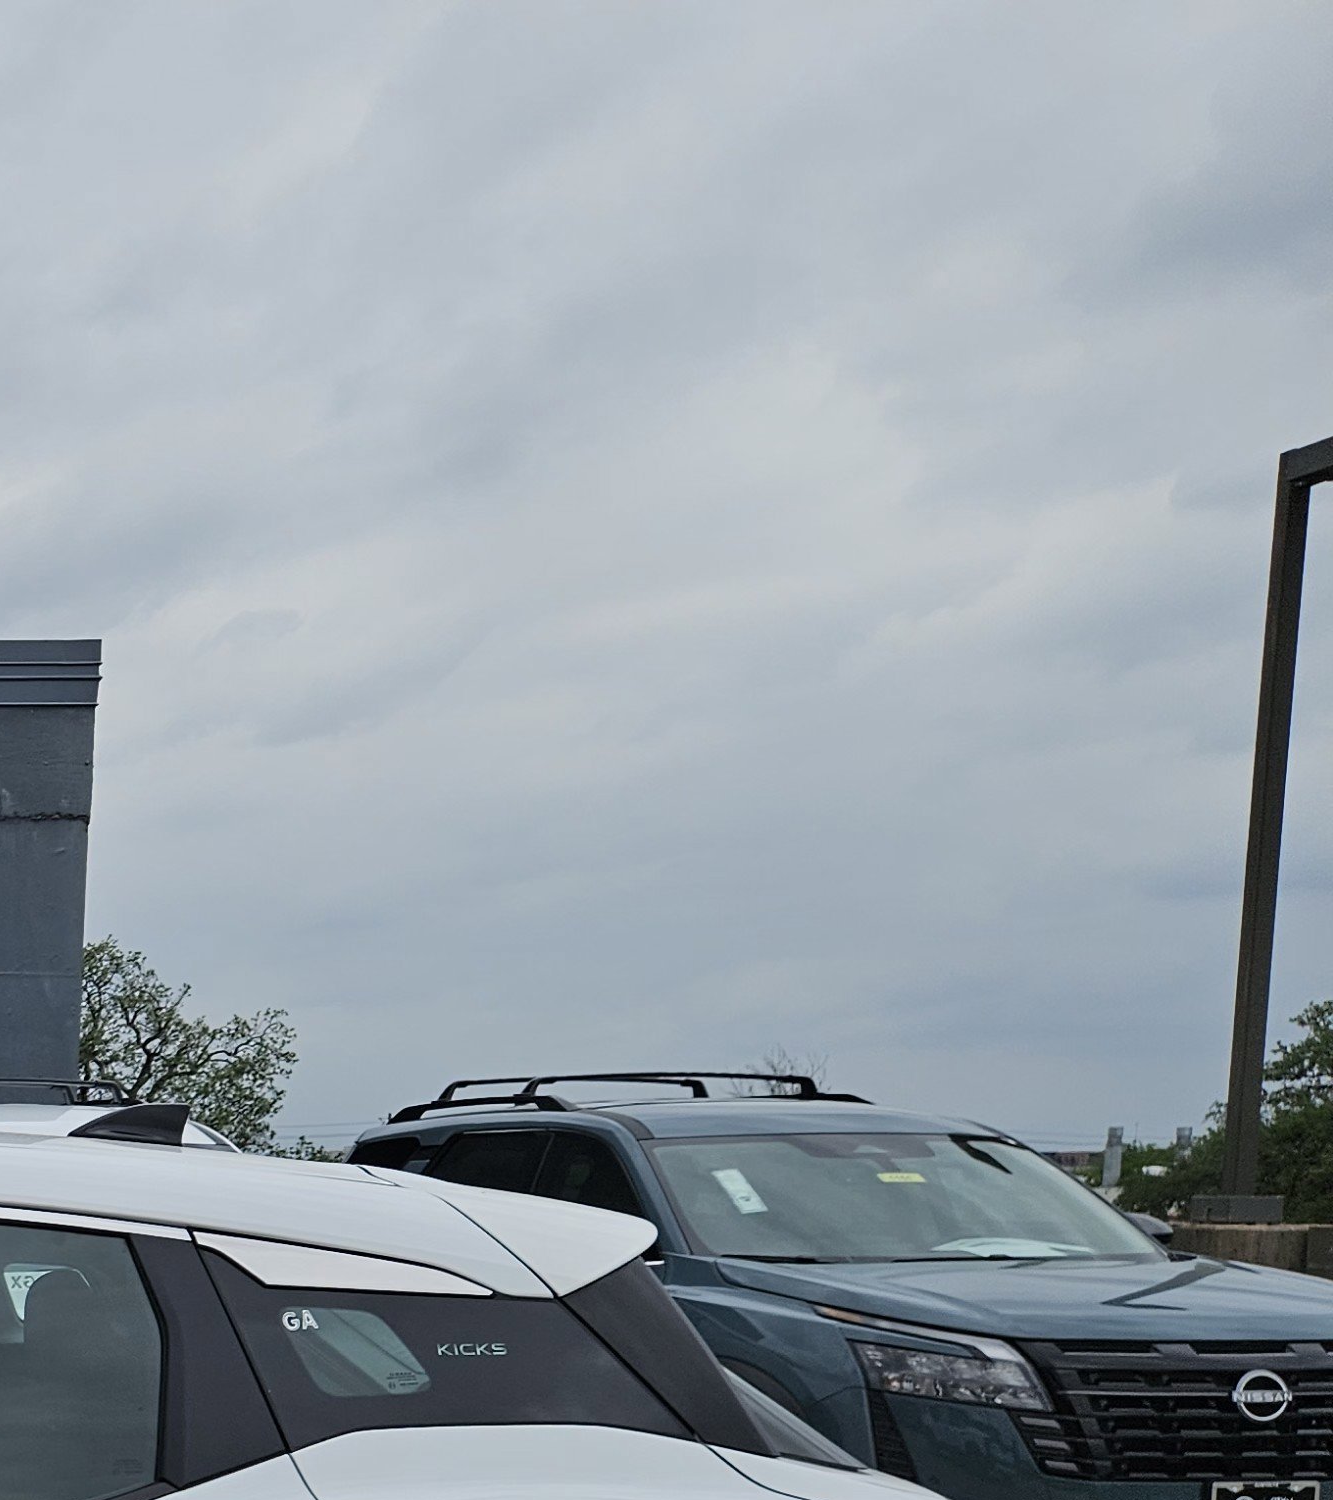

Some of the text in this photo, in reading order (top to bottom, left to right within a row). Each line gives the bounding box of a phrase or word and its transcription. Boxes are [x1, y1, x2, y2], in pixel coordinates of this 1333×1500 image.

[282, 1310, 319, 1331] GA
[436, 1343, 508, 1356] KICKS
[1231, 1390, 1293, 1402] NISSAN
